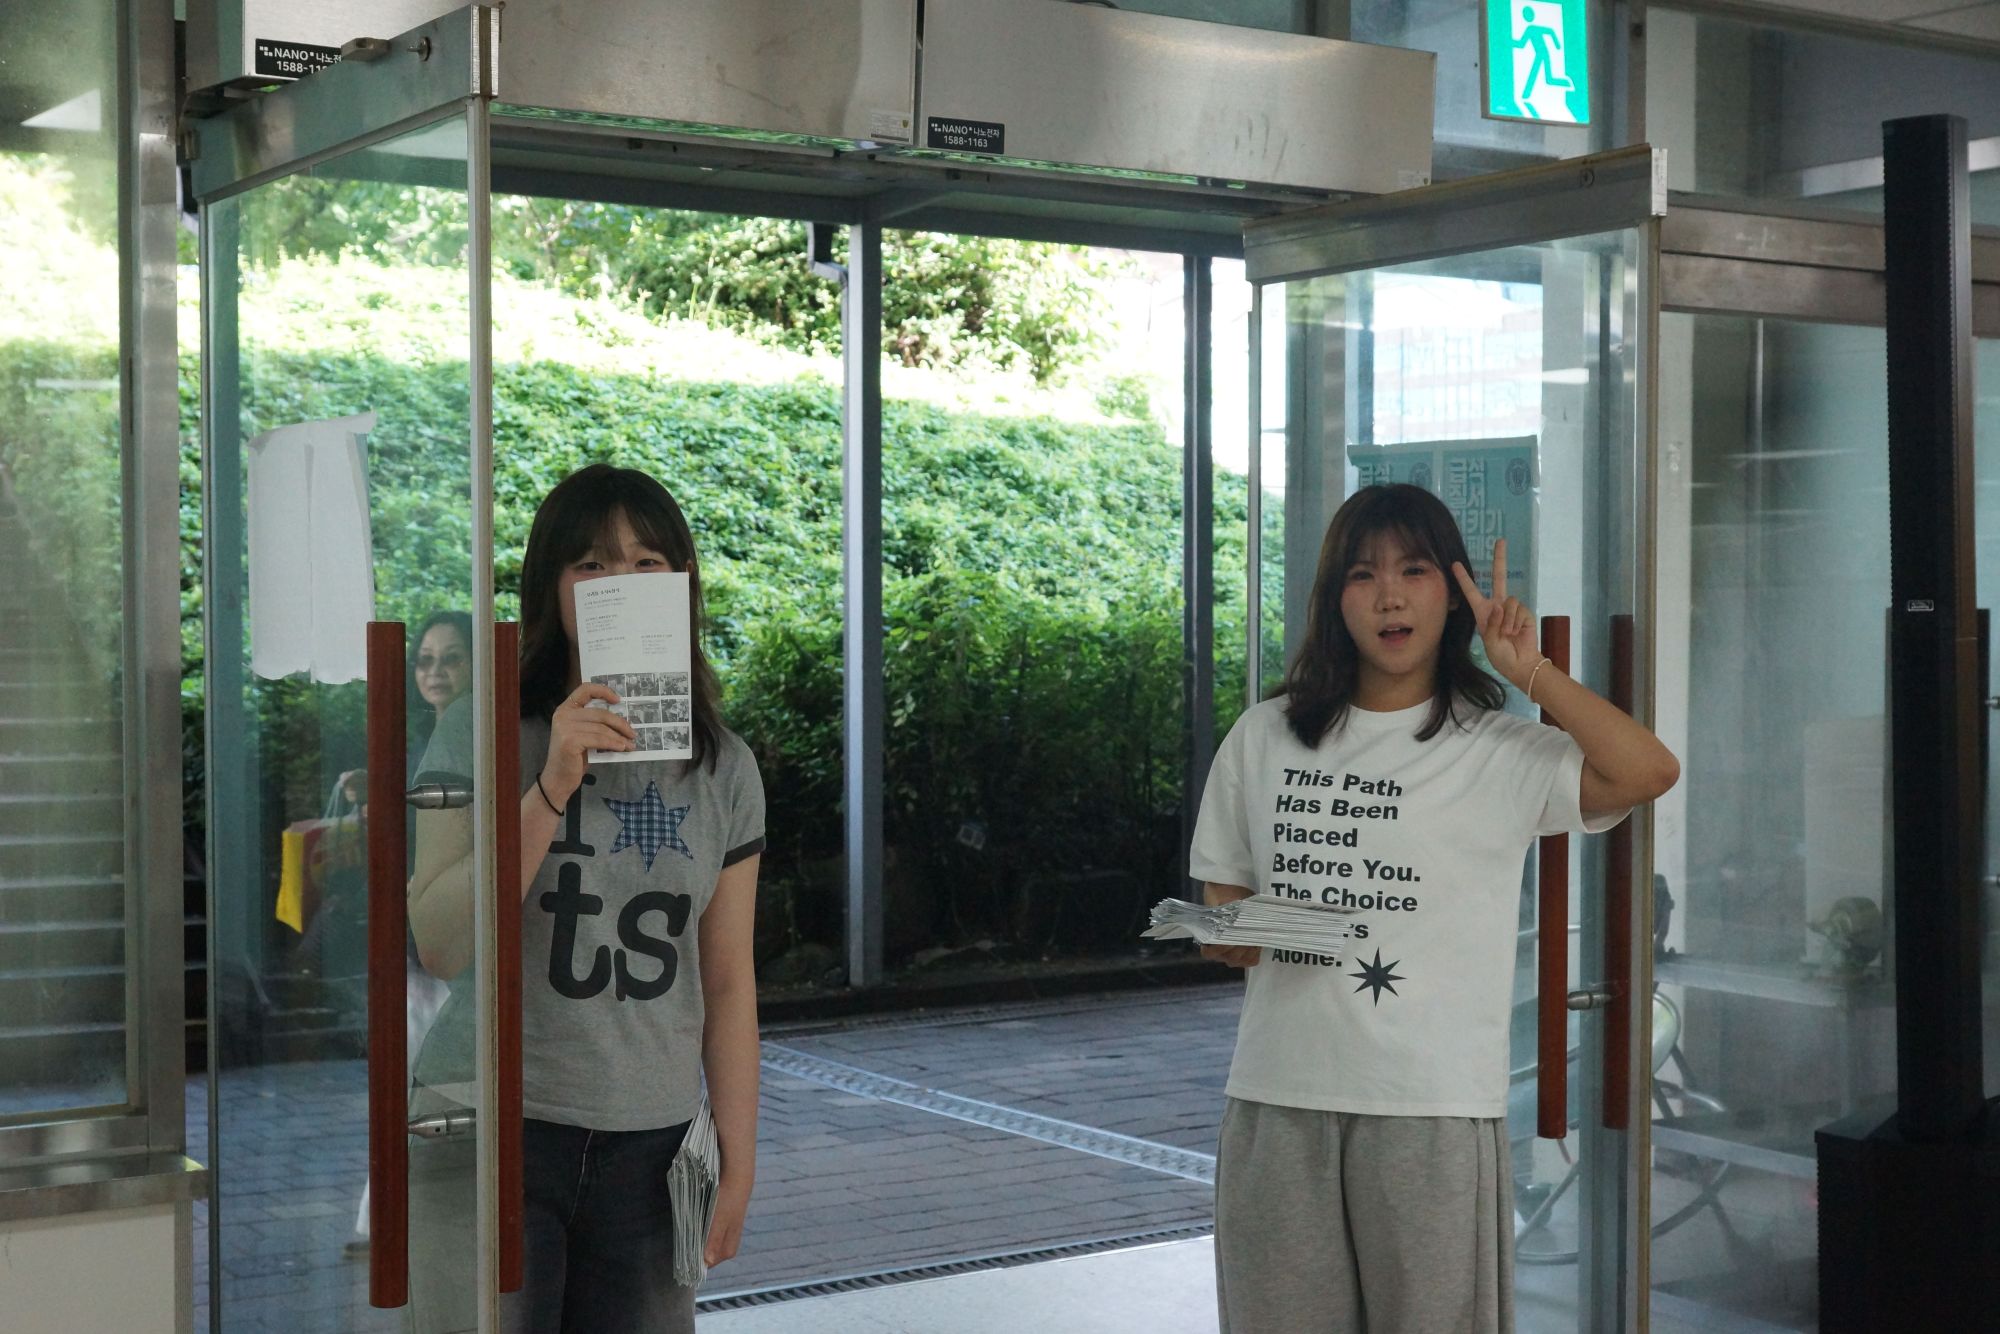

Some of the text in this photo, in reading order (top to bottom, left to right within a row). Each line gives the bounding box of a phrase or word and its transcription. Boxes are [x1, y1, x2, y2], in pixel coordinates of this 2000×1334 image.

[274, 48, 309, 61] NANO
[942, 124, 968, 135] NANO
[943, 135, 988, 148] 1588-1163
[1284, 768, 1403, 797] This Path
[1275, 795, 1399, 820] Has Been
[1272, 853, 1421, 882] Before You.
[1271, 883, 1418, 912] The Choice
[540, 862, 692, 1001] ts
